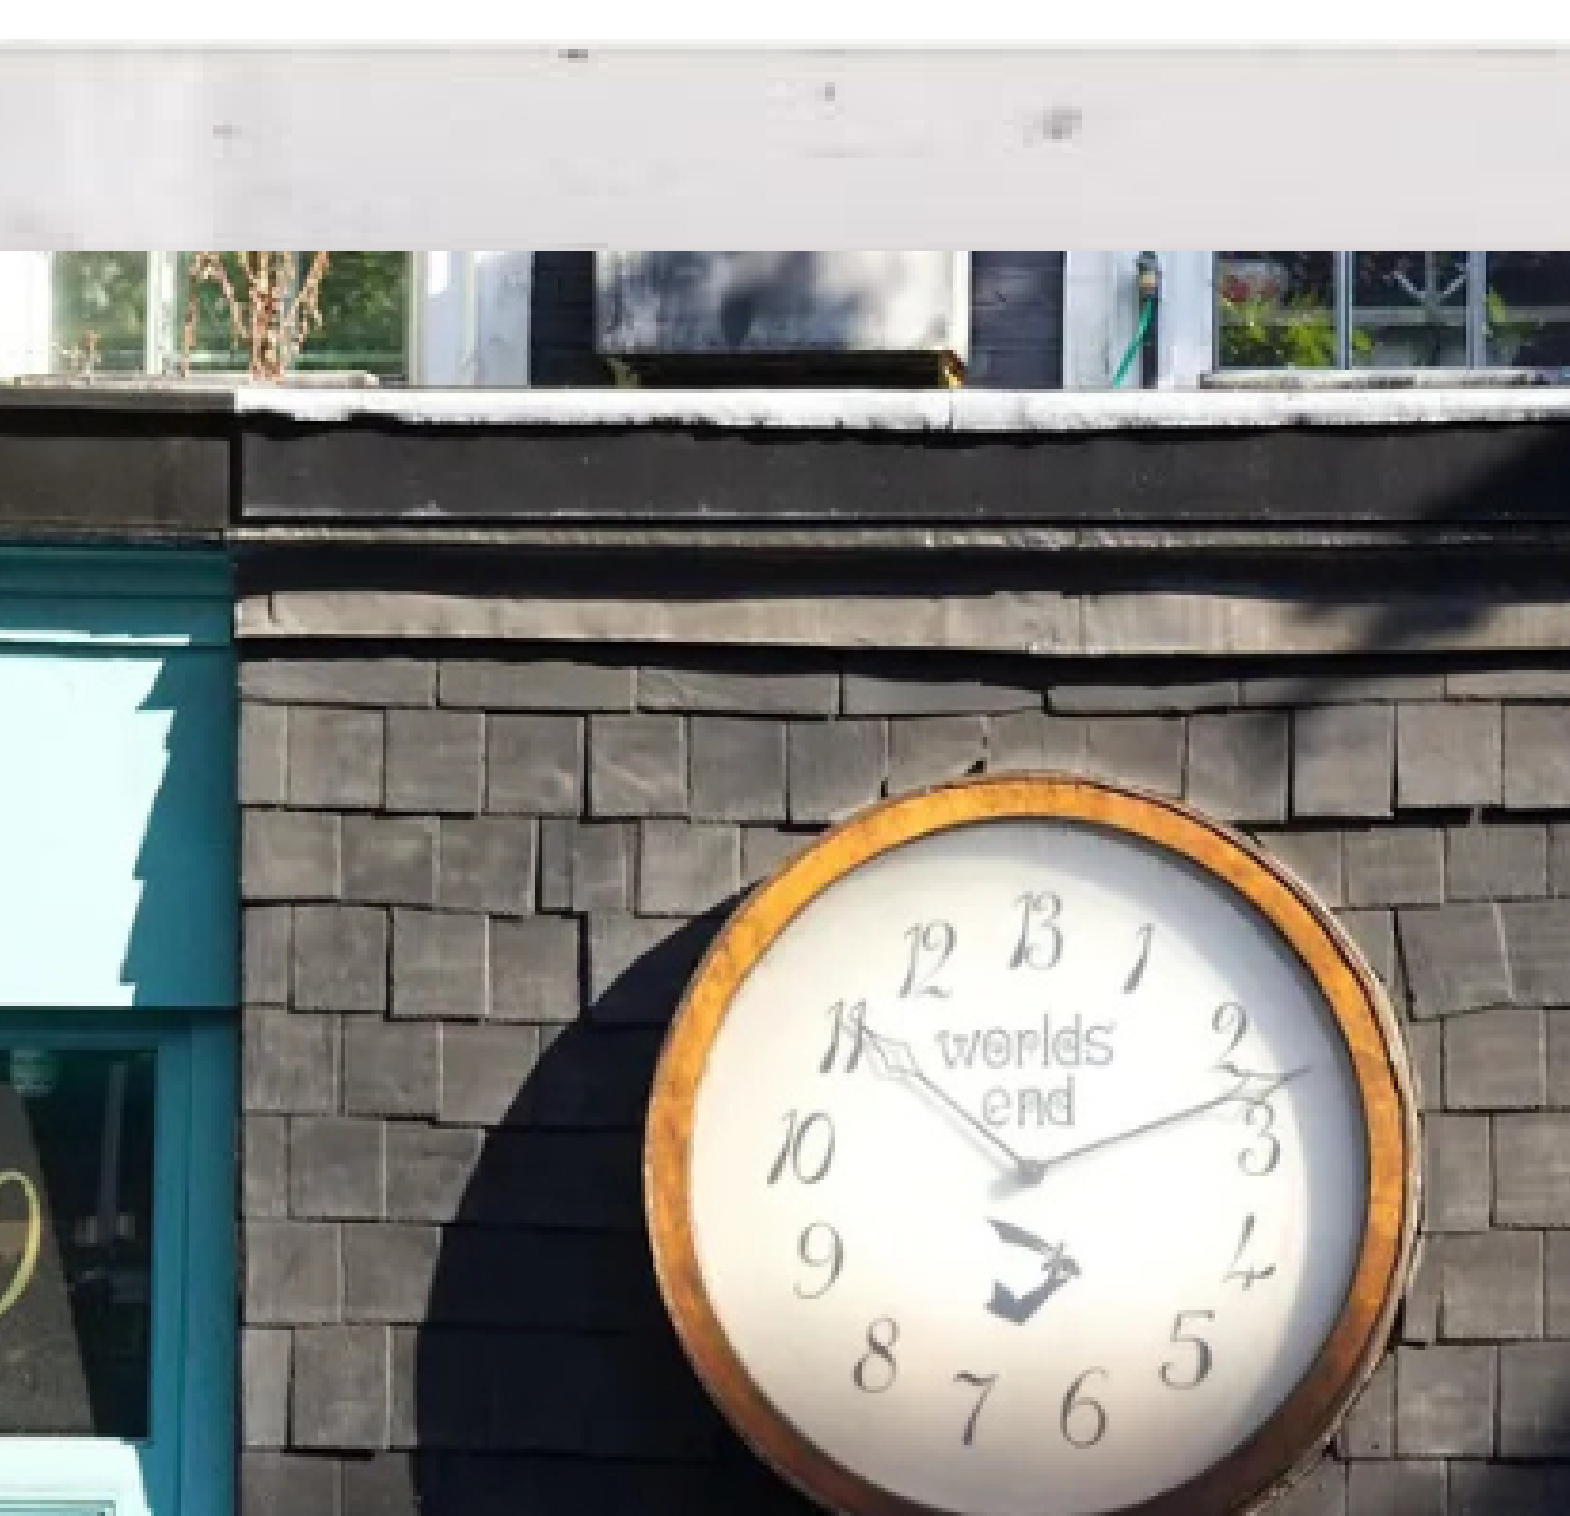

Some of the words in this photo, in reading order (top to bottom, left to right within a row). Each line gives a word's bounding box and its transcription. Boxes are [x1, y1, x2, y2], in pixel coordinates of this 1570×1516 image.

[899, 921, 957, 1000] 12
[1008, 891, 1064, 970] 13
[1122, 922, 1157, 995] 1
[818, 998, 866, 1074] 11
[935, 1011, 1116, 1068] worlds
[1212, 1001, 1254, 1077] 2
[983, 1073, 1076, 1126] end
[1237, 1100, 1282, 1176] 3
[766, 1109, 836, 1186] 10
[791, 1222, 845, 1300] 9
[1224, 1212, 1278, 1292] 4
[852, 1317, 901, 1395] 8
[1157, 1309, 1216, 1391] 5
[953, 1369, 1000, 1447] 7
[1058, 1368, 1110, 1450] 6
